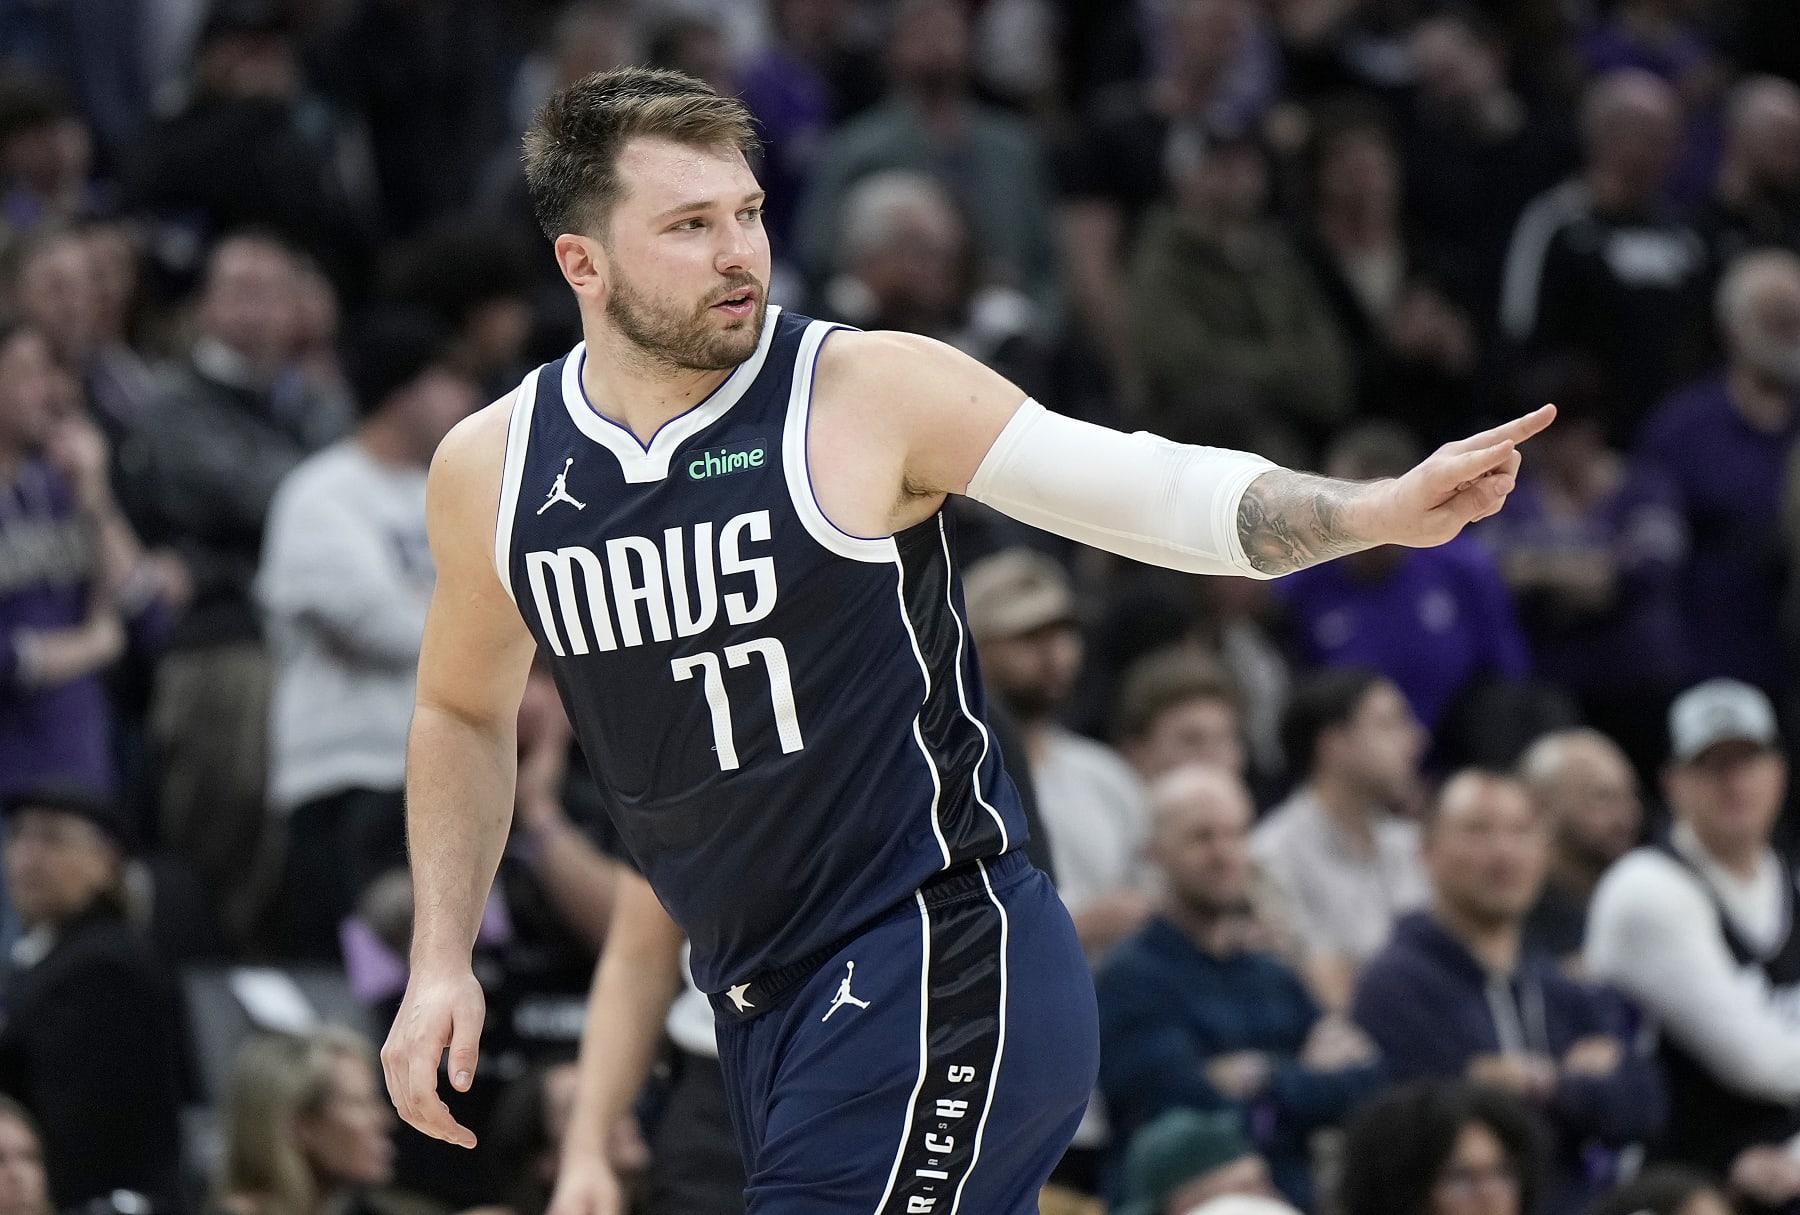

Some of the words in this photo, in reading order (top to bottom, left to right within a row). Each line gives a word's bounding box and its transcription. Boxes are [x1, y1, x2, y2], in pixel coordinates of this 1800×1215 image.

[689, 448, 764, 479] chime
[525, 510, 778, 657] MAVS
[671, 637, 804, 771] 77
